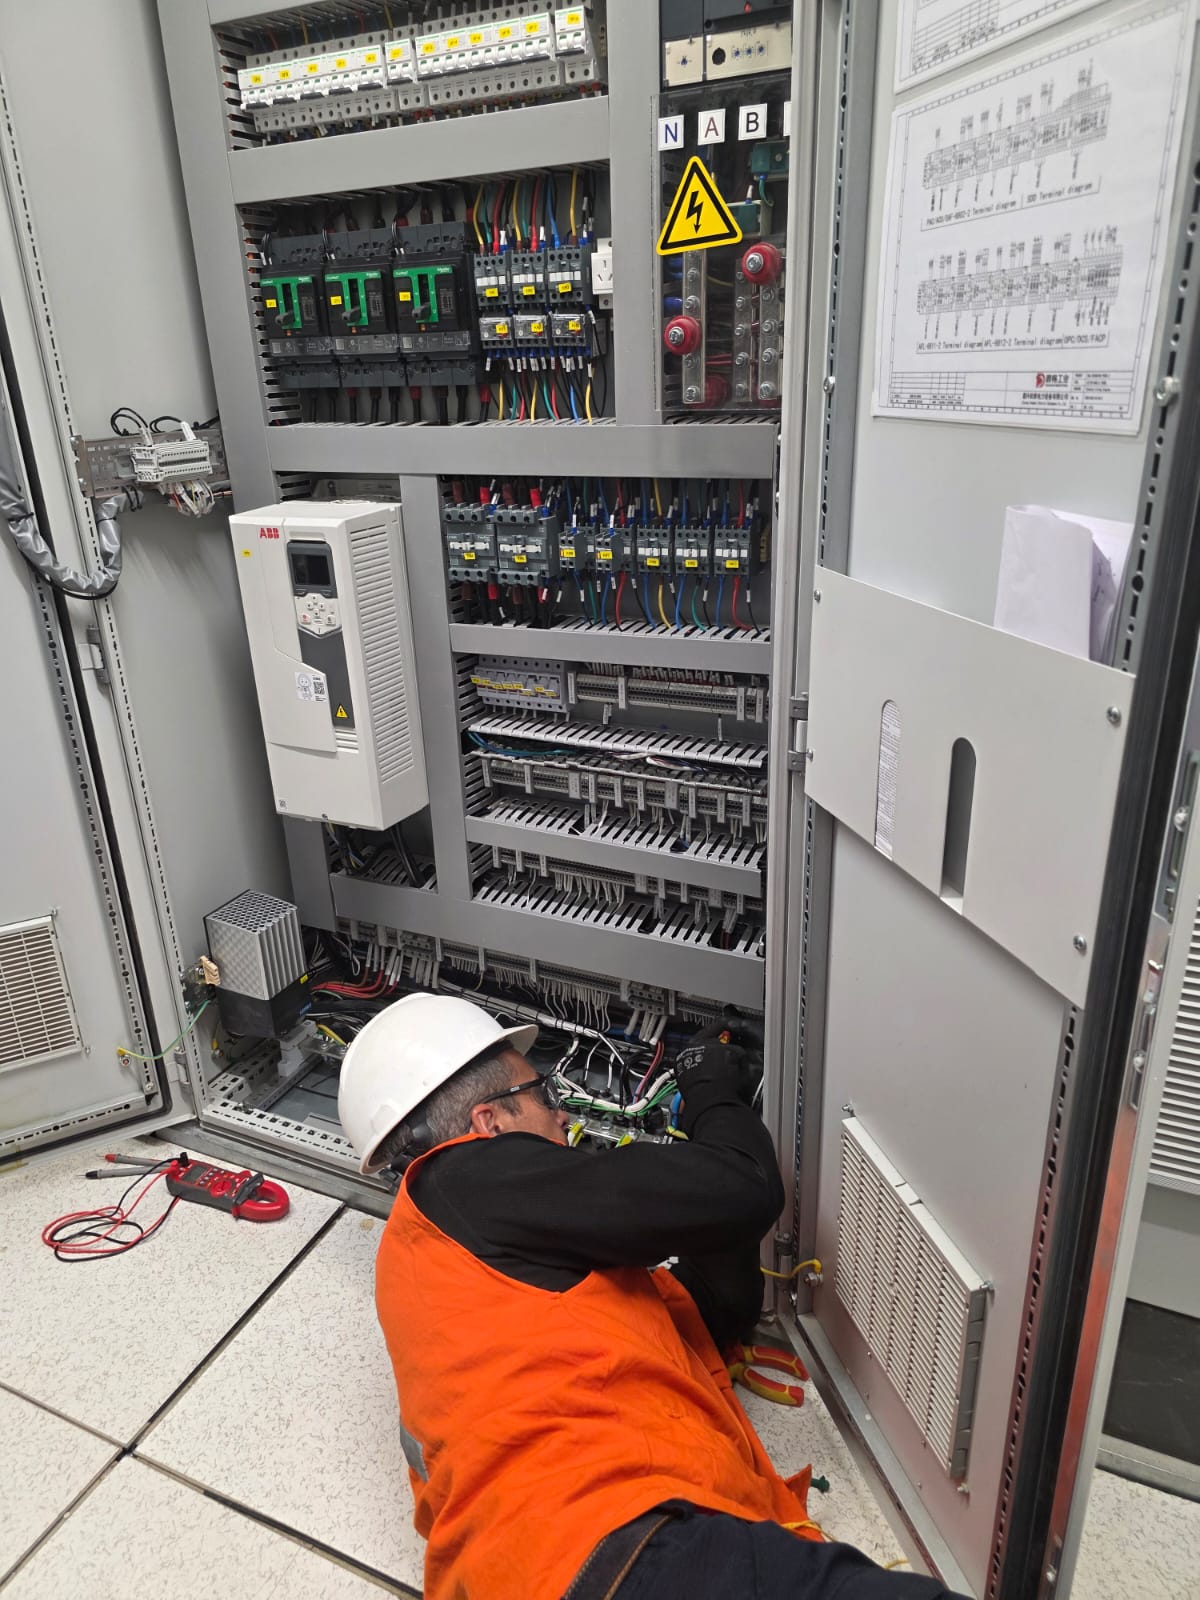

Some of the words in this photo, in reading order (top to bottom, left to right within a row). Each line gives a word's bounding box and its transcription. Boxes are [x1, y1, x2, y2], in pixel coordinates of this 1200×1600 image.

[664, 122, 678, 144] N
[704, 116, 719, 138] A
[746, 111, 760, 133] B
[260, 528, 280, 539] ABB
